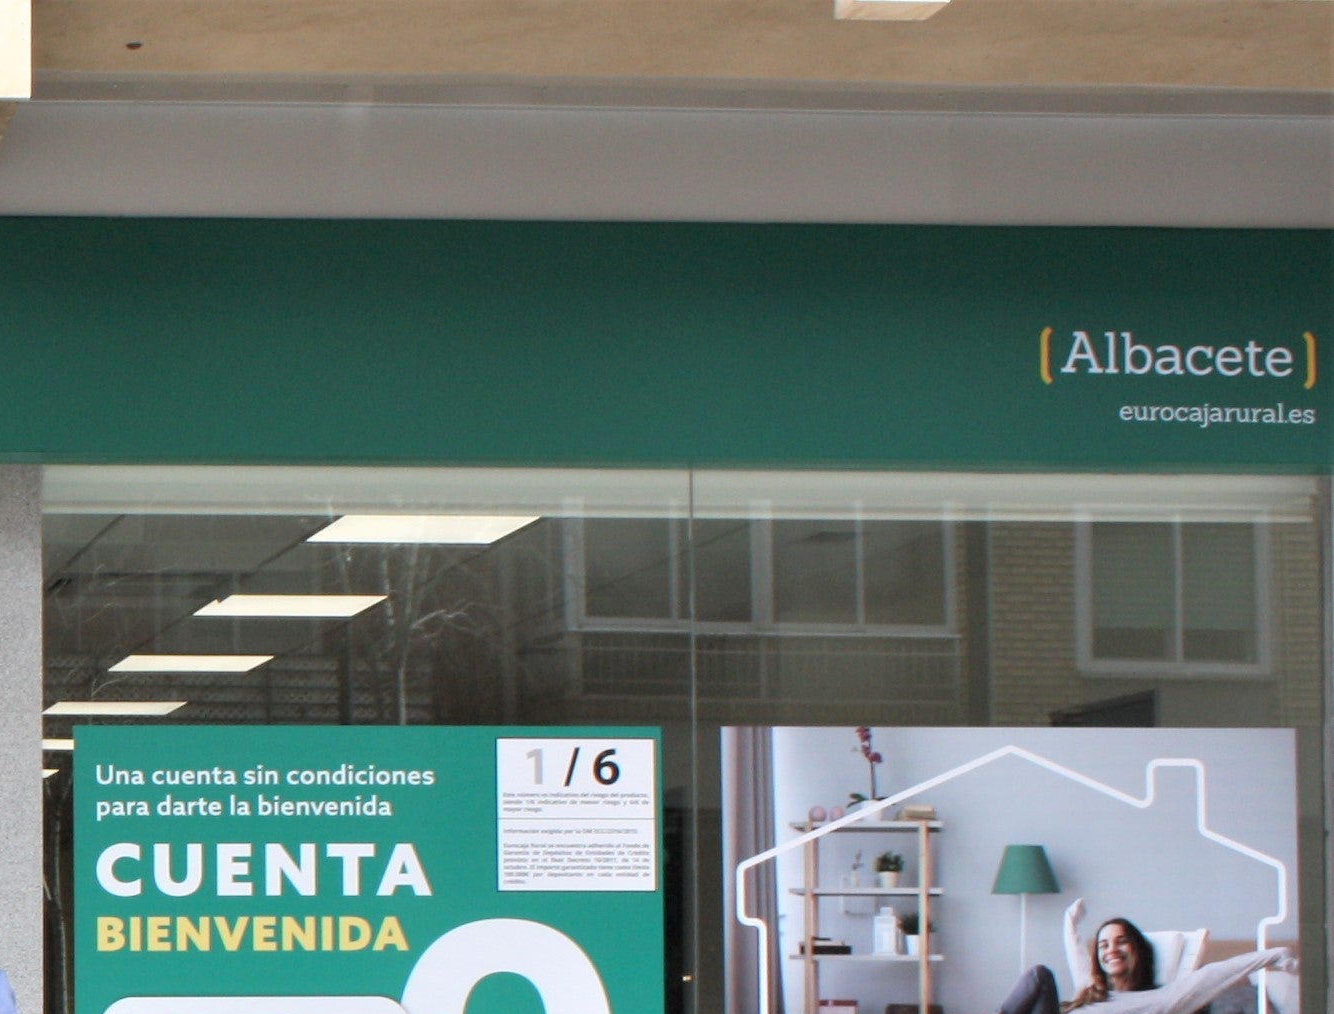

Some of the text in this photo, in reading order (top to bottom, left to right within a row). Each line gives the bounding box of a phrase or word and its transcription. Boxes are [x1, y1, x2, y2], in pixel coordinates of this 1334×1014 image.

[1119, 402, 1316, 428] eurocajarural.es
[95, 762, 435, 786] Una cuenta sin condiciones
[526, 747, 620, 787] 1 / 6
[95, 794, 392, 822] para darte la bienvenida
[95, 842, 432, 898] CUENTA
[96, 915, 410, 952] BIENVENIDA
